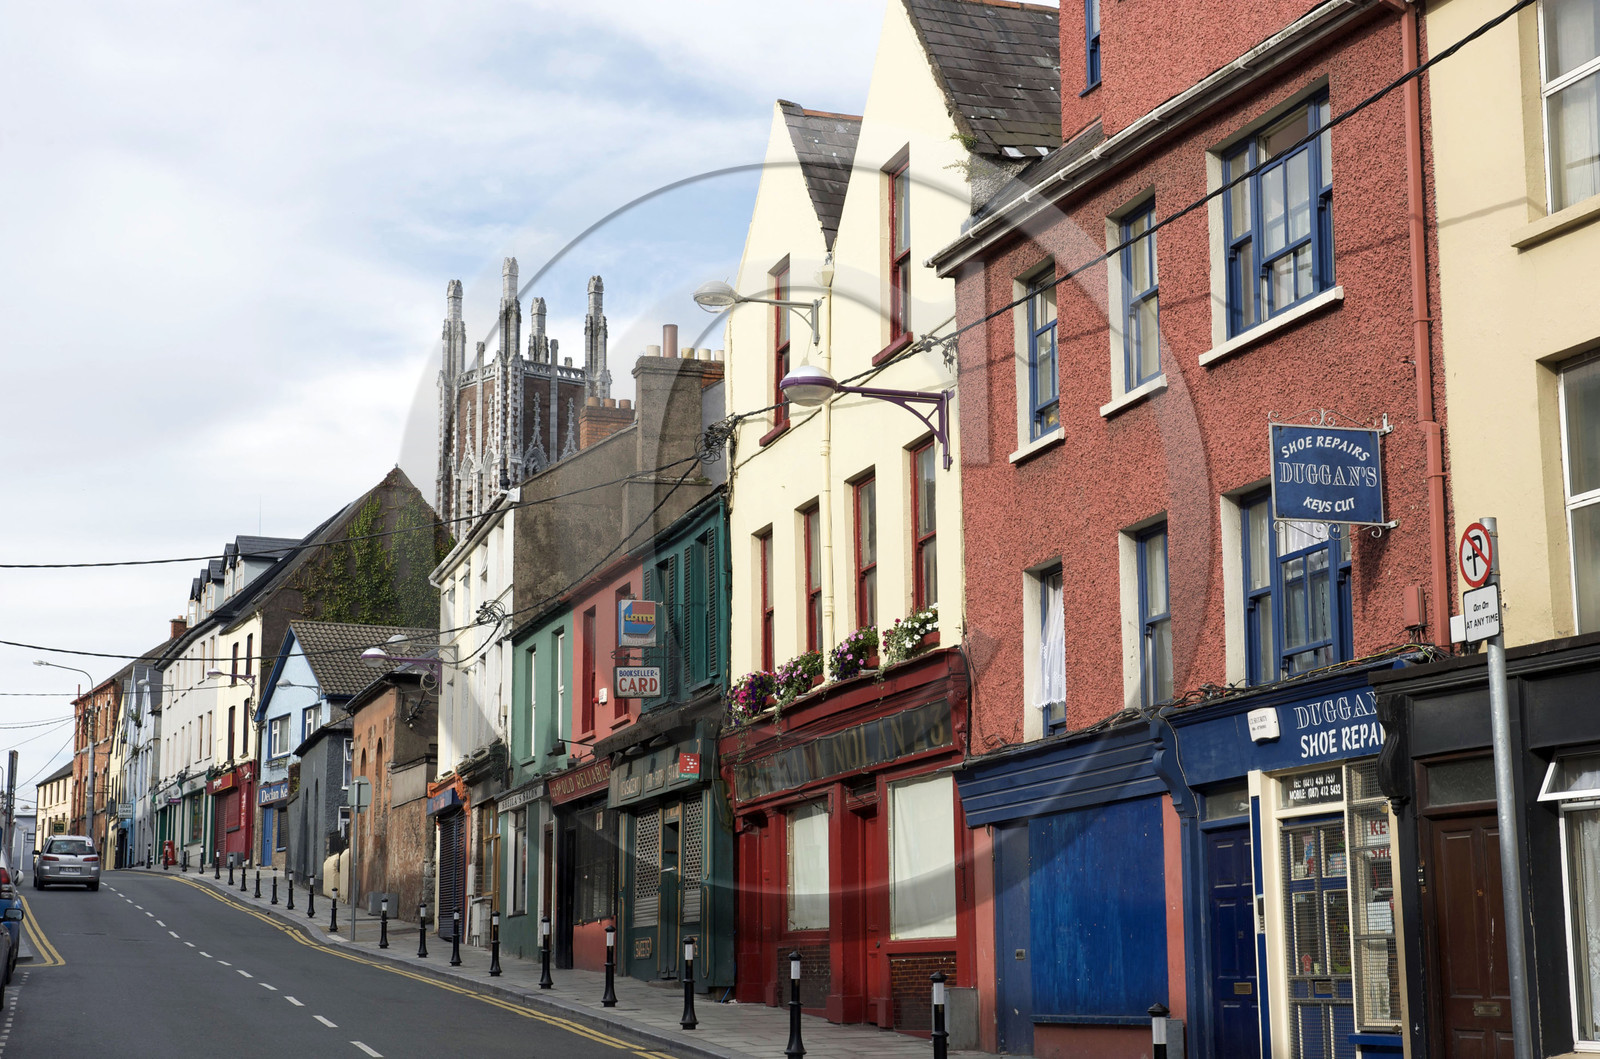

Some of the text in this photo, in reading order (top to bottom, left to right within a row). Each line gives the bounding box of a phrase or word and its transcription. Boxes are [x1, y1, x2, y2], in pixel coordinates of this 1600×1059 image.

[1281, 436, 1370, 461] SHOE REPAIRS
[1278, 462, 1378, 488] DUGGAN'S
[1303, 497, 1355, 513] KEYS CUT
[625, 613, 656, 623] LOTTO
[1466, 613, 1498, 630] AT ANY TIME
[619, 678, 658, 692] CARD
[1301, 729, 1337, 758] SHOE
[561, 778, 575, 794] OLD
[576, 763, 611, 790] RELIABLE
[261, 788, 279, 803] Declan
[1320, 785, 1329, 796] 412
[1330, 783, 1341, 796] 5432
[1370, 819, 1390, 835] KE
